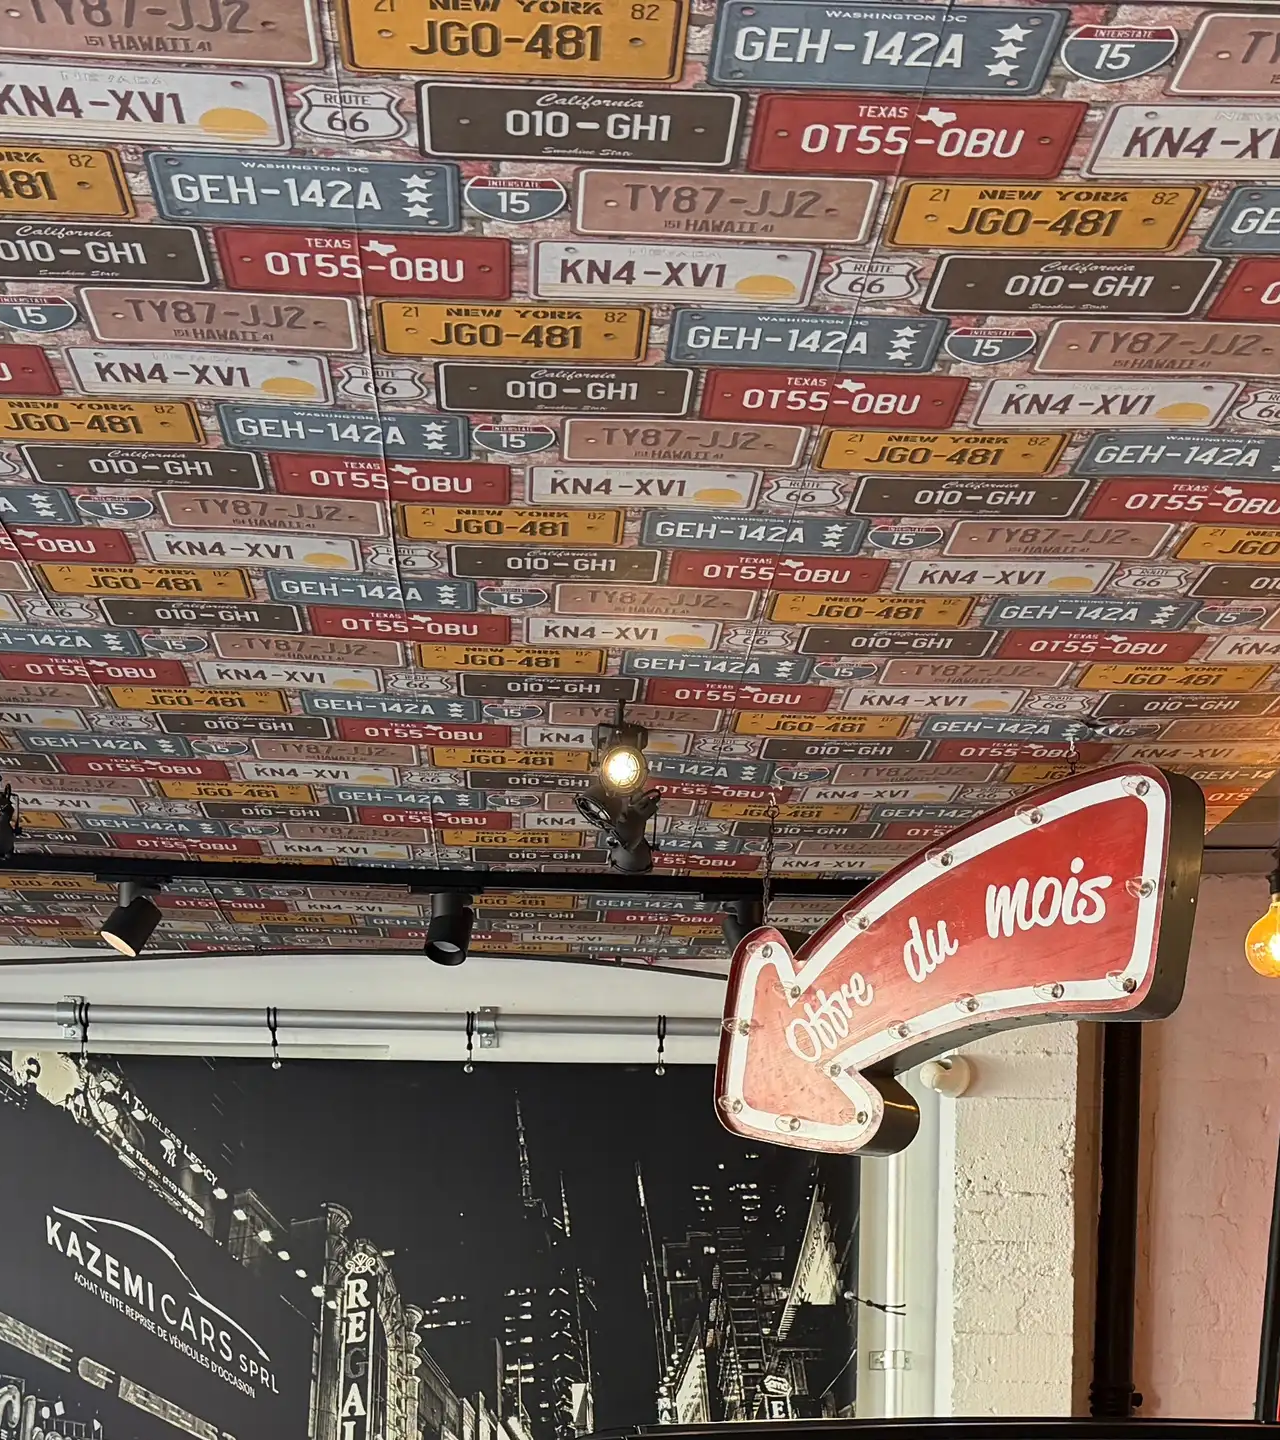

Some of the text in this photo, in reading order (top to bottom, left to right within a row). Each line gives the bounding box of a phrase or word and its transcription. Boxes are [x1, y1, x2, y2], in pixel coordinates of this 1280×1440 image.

[939, 12, 967, 24] DC
[1091, 27, 1156, 40] INTERSTATE
[733, 26, 966, 70] GEH-142A
[1094, 44, 1132, 71] 15
[322, 93, 373, 107] ROUTE
[536, 92, 645, 111] California
[326, 109, 370, 134] 66
[857, 103, 909, 120] TEXAS
[68, 153, 97, 169] 82
[340, 165, 369, 175] DC
[171, 172, 383, 212] GEH-142A
[624, 182, 822, 217] TY87-JJ2
[978, 188, 1130, 203] NEW YORK
[14, 224, 116, 241] California
[305, 237, 352, 251] TEXAS
[852, 262, 897, 275] ROUTE
[847, 276, 885, 296] 66
[122, 299, 310, 330] TY87-JJ2
[686, 324, 870, 357] GEH-142A
[971, 338, 1004, 358] 15
[1093, 444, 1258, 473] GEH-142A
[903, 916, 959, 983] du
[985, 856, 1113, 938] mois
[74, 1272, 98, 1295] ACHAT
[100, 1287, 124, 1313] VENTE
[125, 1304, 156, 1333] REPRISE
[157, 1325, 168, 1341] DE
[239, 1354, 279, 1394] SPRL
